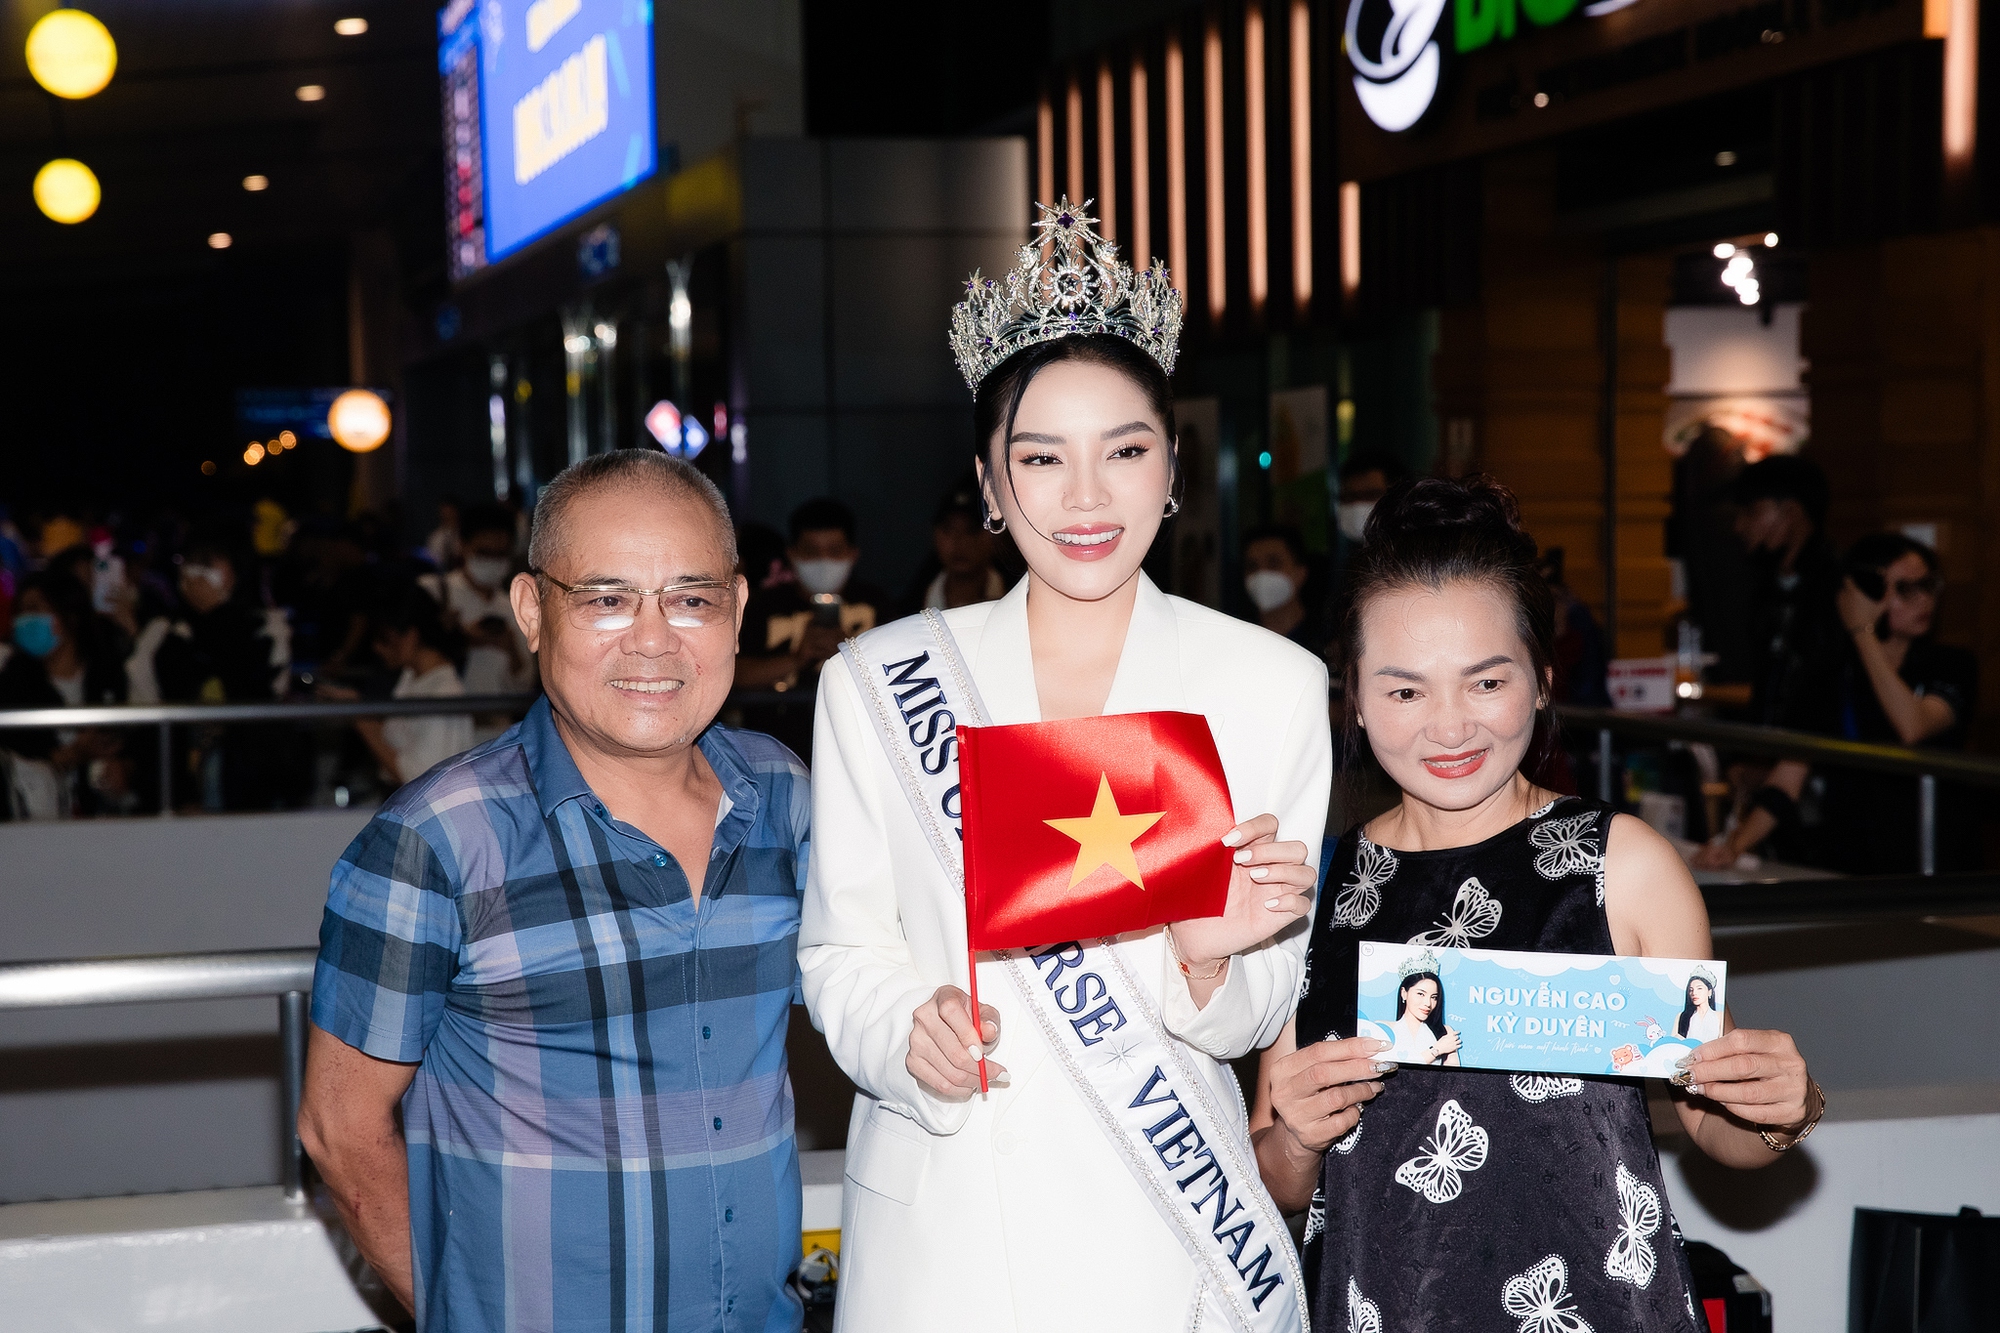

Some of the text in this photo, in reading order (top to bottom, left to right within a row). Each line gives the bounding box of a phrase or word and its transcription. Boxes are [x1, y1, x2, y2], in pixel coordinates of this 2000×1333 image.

[882, 650, 959, 776] MISS
[1127, 1064, 1285, 1313] VIETNAM
[1469, 981, 1627, 1012] NGUYỄN CAO
[1486, 1011, 1606, 1038] KỲ DUYÊN
